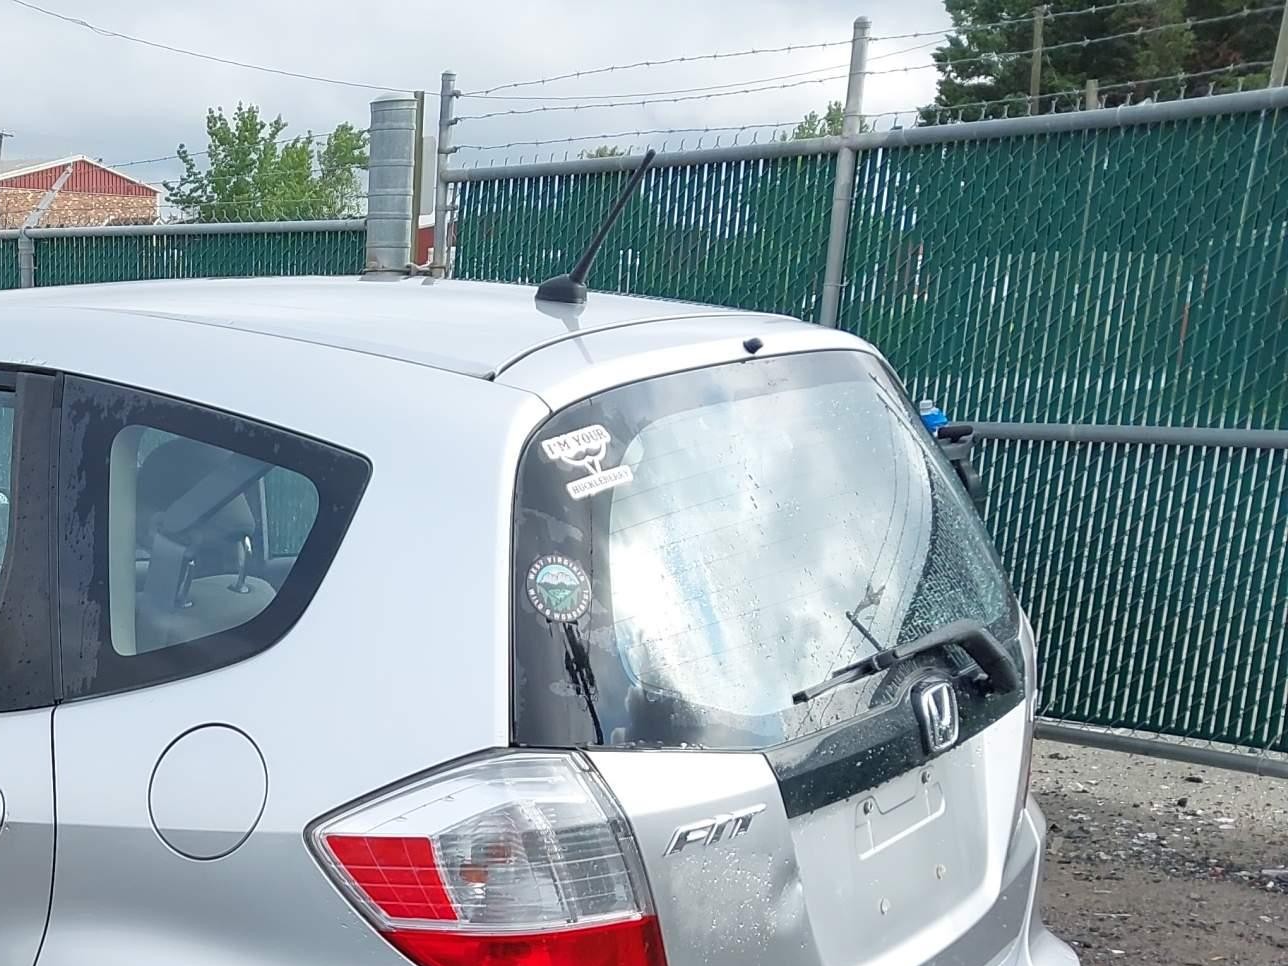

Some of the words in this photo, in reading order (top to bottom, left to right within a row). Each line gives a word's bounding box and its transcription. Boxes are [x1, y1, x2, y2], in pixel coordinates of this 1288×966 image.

[546, 439, 571, 455] I'M
[571, 428, 607, 447] YOUR
[662, 803, 767, 857] FIT
